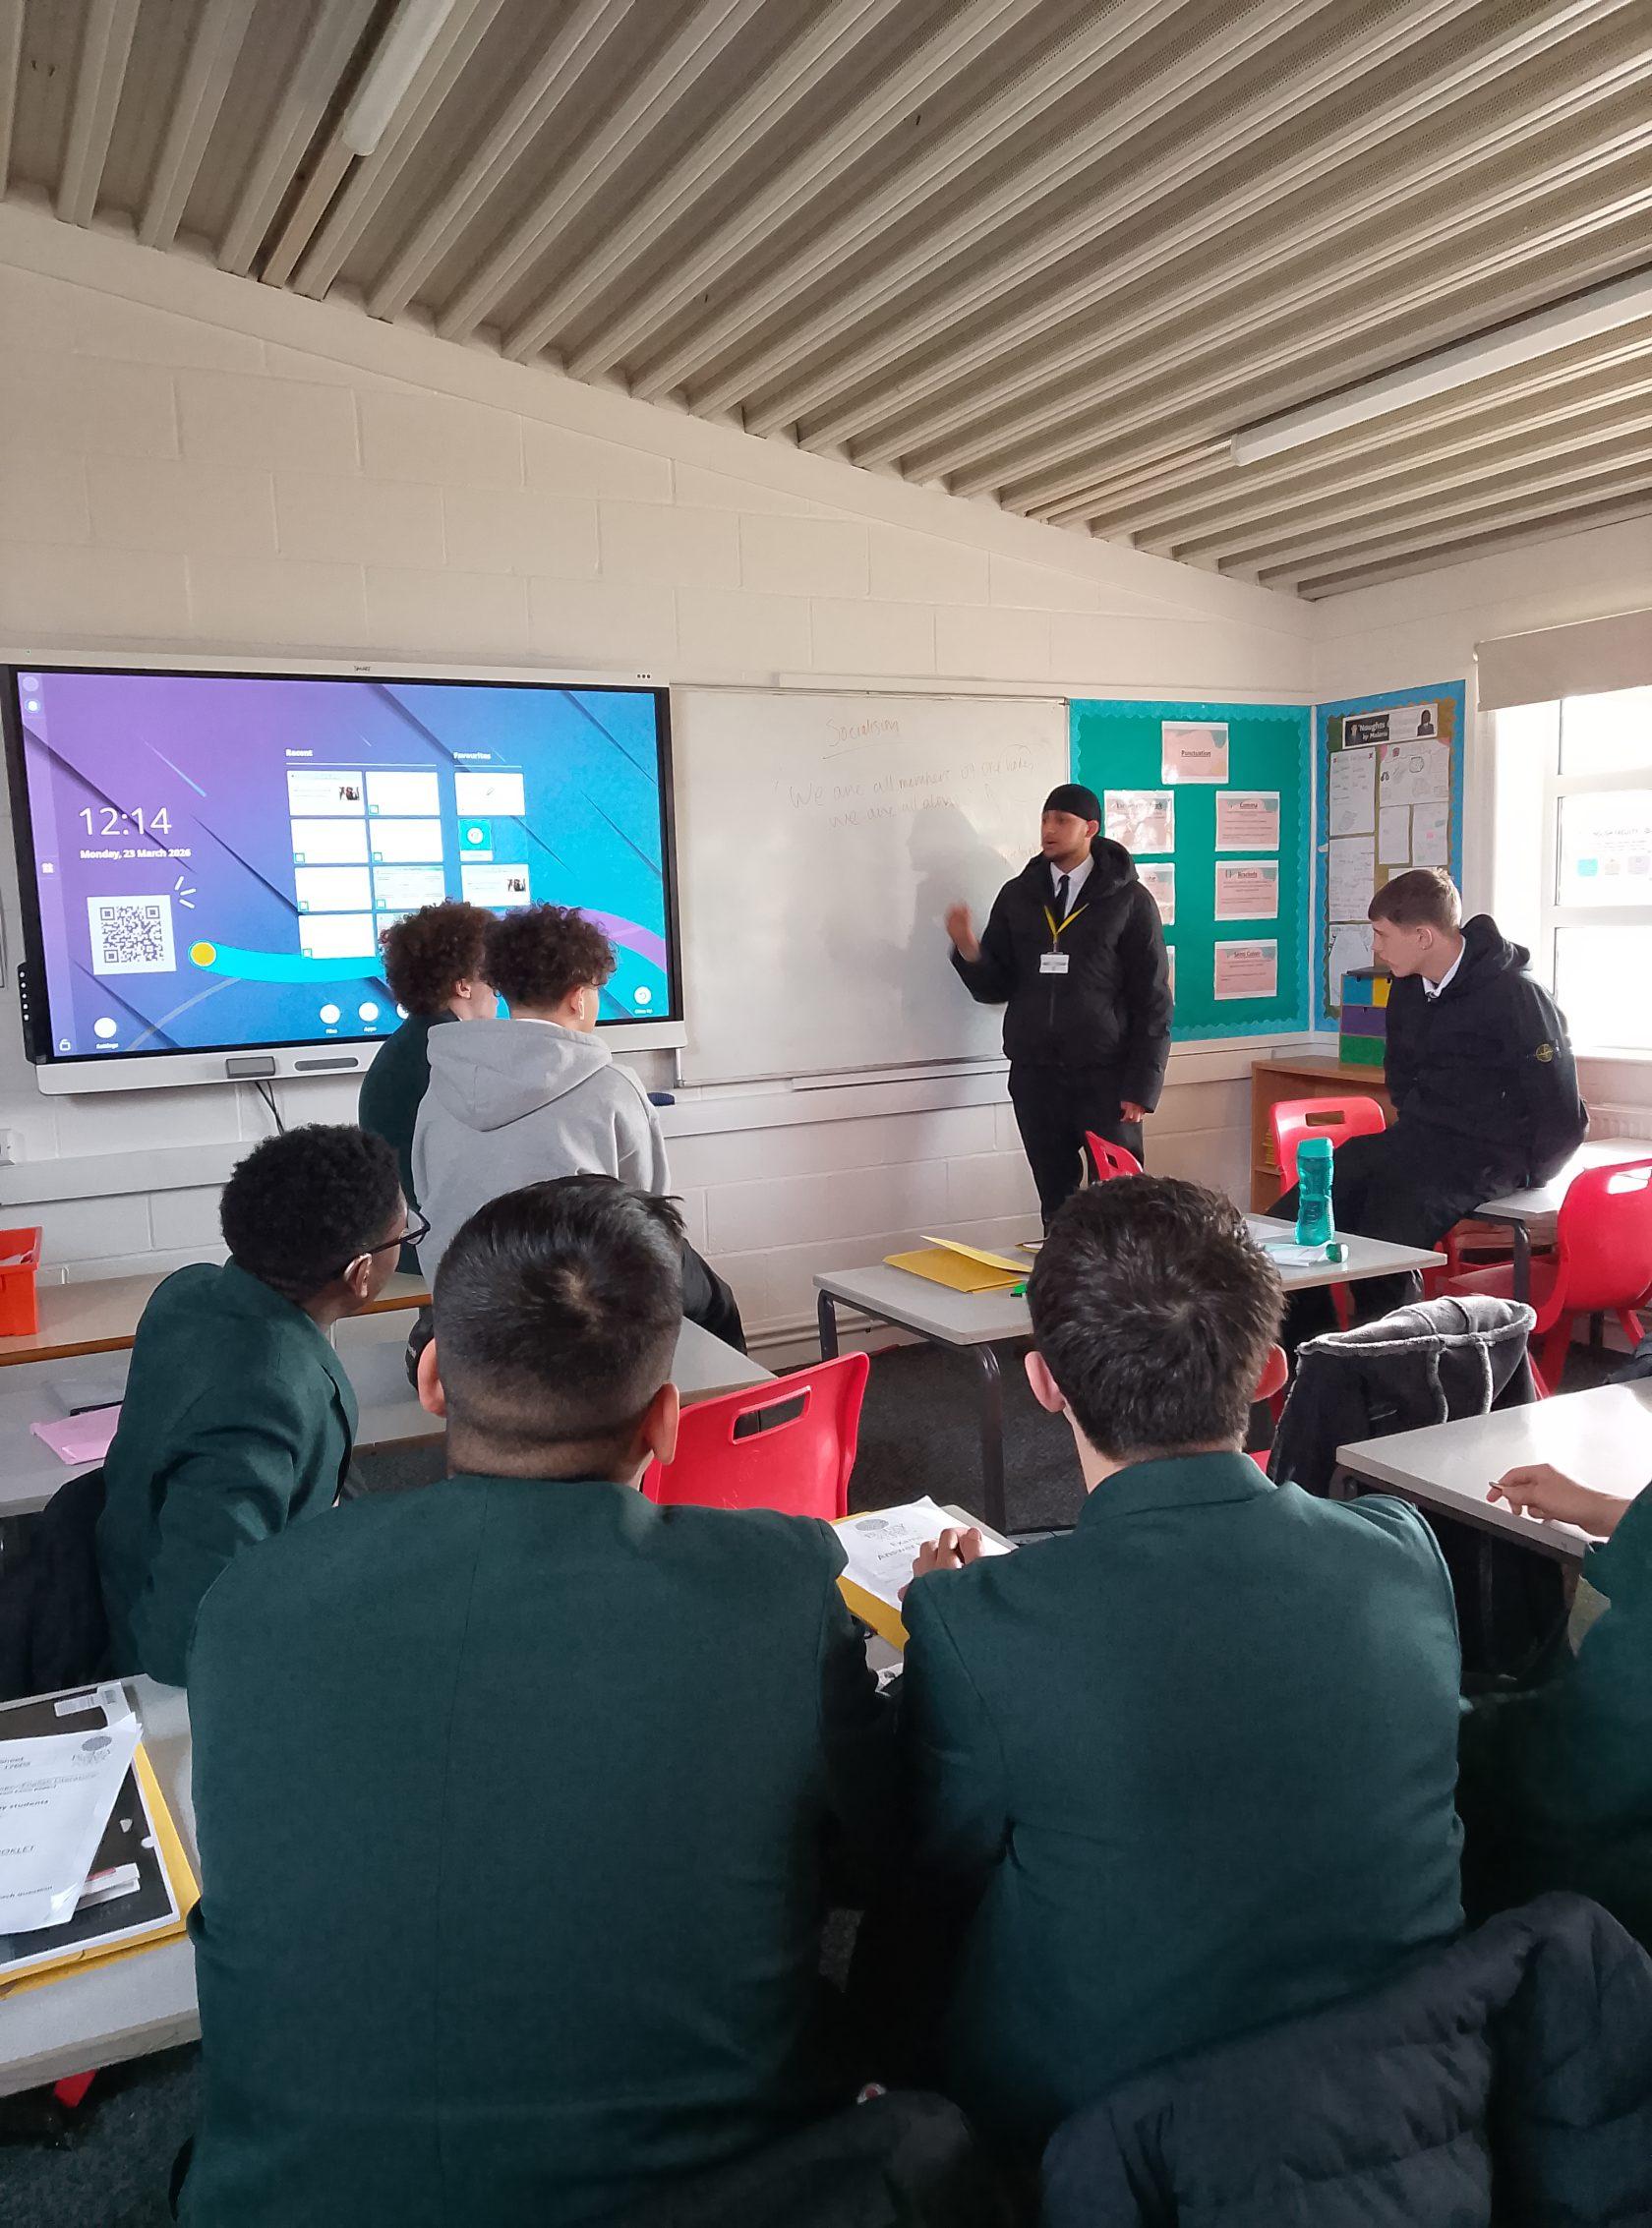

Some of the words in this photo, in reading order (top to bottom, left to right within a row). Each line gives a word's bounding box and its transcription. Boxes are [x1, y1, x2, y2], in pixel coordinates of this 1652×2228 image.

[285, 748, 314, 757] Recent
[453, 751, 492, 760] Favourites
[79, 807, 172, 836] 12:14
[80, 850, 122, 860] Monday,
[123, 850, 136, 858] 23
[138, 849, 167, 858] March
[168, 848, 192, 857] 2026
[10, 1799, 48, 1809] students
[0, 1845, 35, 1856] OKLET
